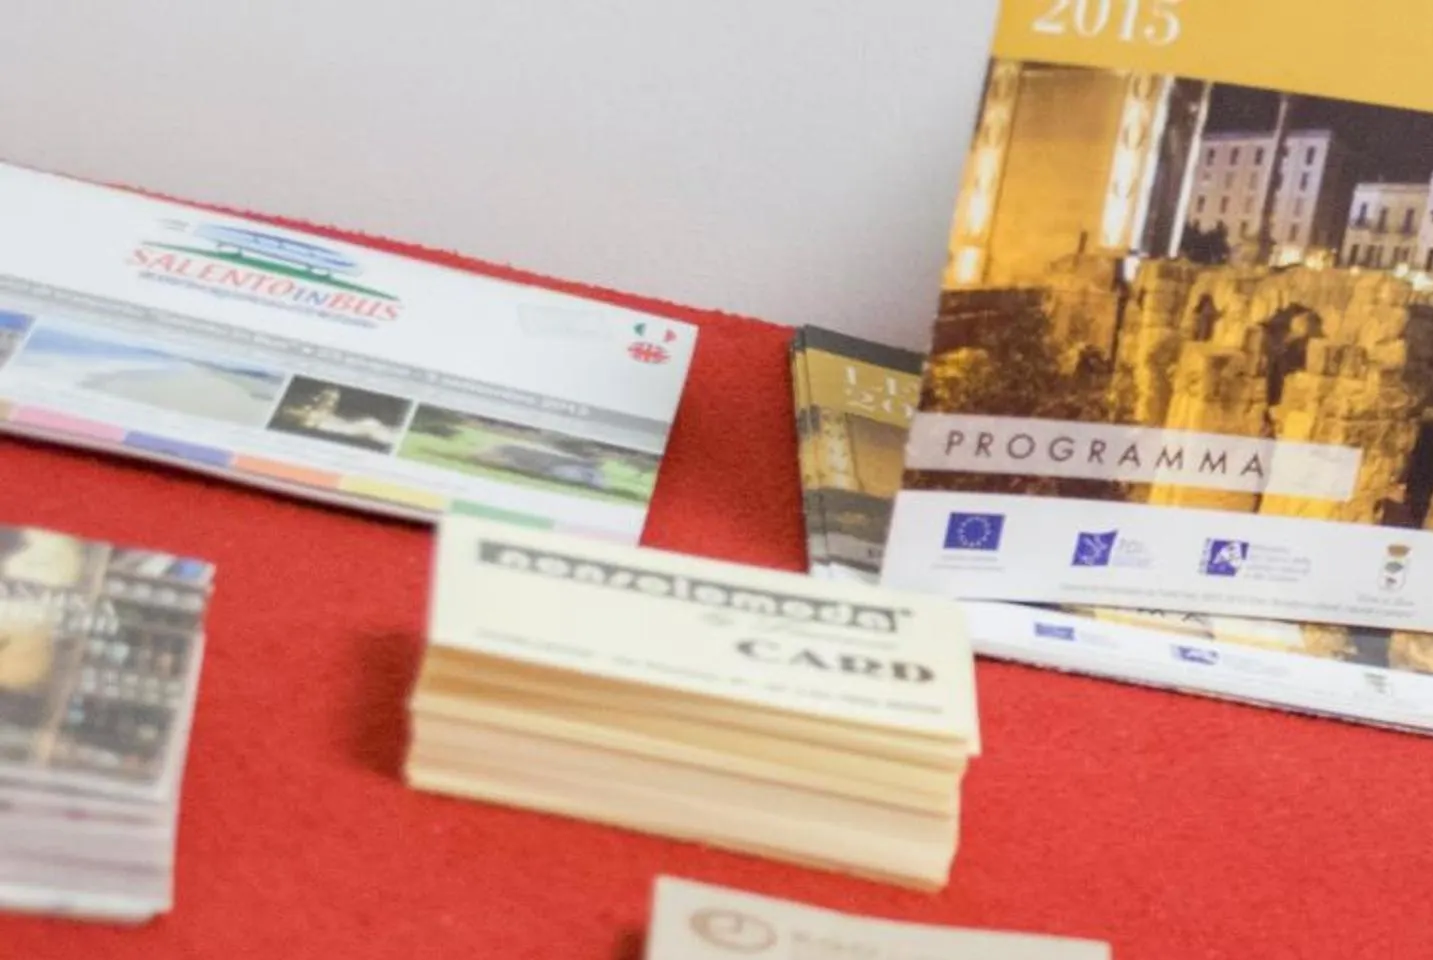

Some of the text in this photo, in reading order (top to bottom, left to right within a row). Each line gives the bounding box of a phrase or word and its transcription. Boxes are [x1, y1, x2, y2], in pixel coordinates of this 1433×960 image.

[1031, 0, 1182, 46] 2015
[944, 429, 1265, 478] PROGRAMMA
[735, 637, 937, 684] CARD
